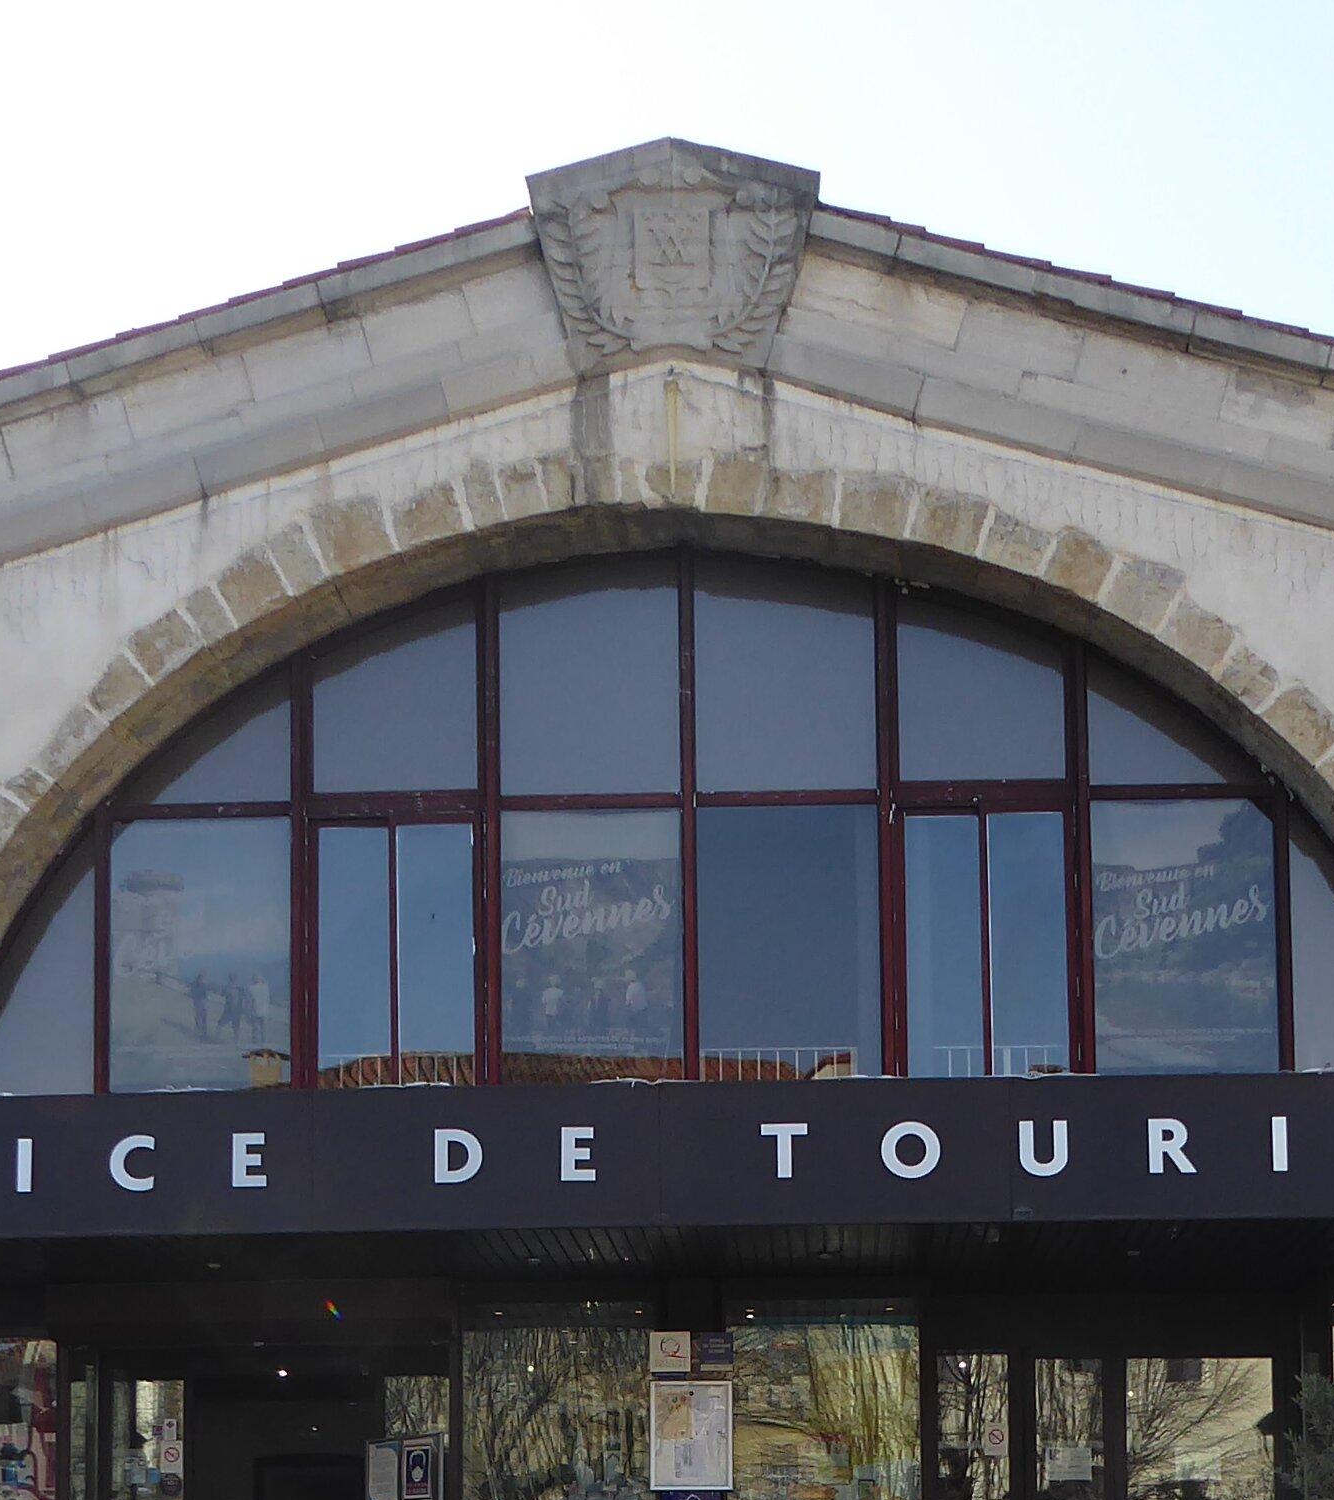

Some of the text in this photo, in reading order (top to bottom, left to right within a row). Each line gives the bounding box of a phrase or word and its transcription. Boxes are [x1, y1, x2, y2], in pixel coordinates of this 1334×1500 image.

[504, 861, 623, 888] Bienvenue en
[1097, 864, 1215, 891] Bienvenue en
[537, 879, 592, 916] Sud
[1134, 883, 1189, 920] Sud
[502, 883, 674, 955] Cévennes
[1093, 884, 1271, 960] Cévennes
[433, 1125, 597, 1186] DE
